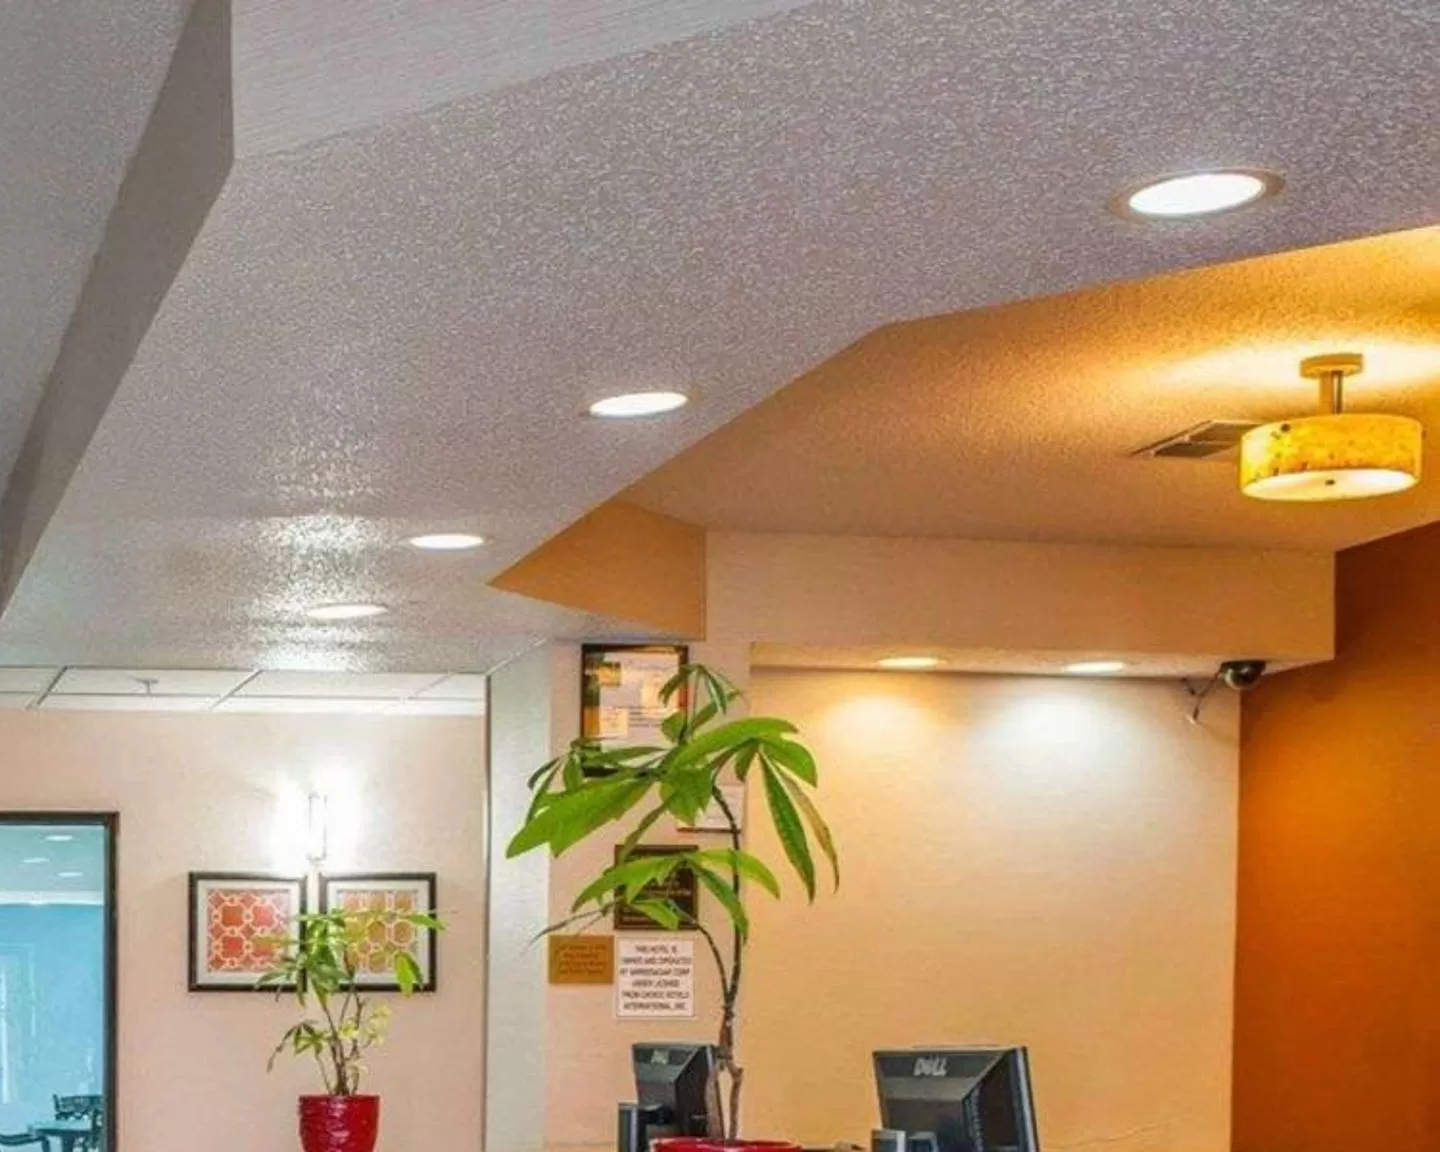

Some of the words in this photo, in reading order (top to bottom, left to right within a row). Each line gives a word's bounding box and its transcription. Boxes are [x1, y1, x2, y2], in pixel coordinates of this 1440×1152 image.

[659, 957, 692, 965] OPERATED
[641, 991, 665, 999] CHOICE
[666, 991, 690, 999] HOTELS
